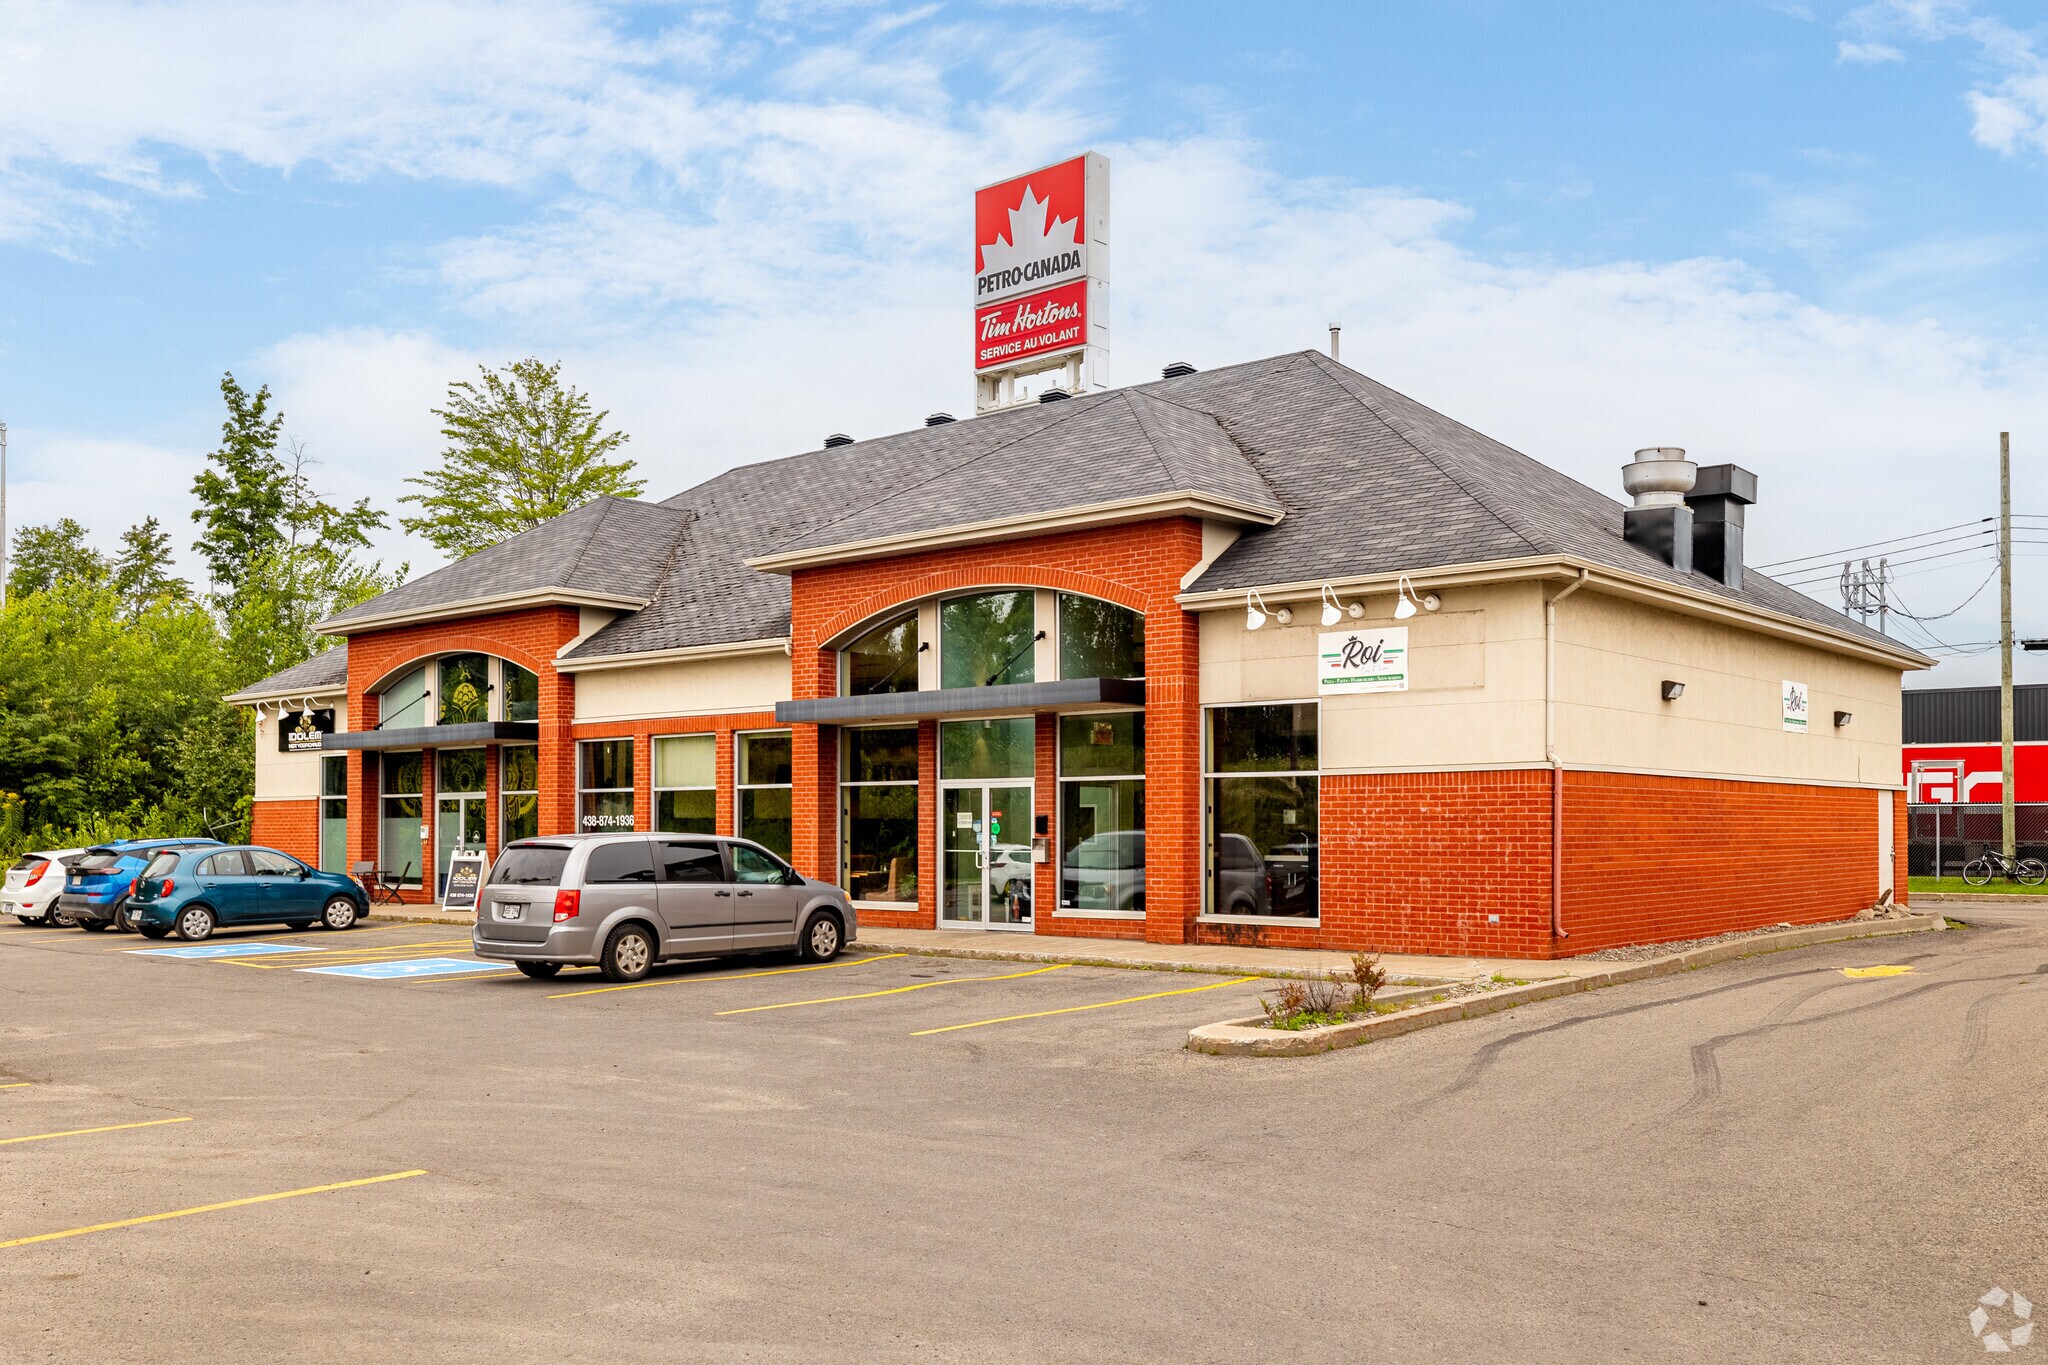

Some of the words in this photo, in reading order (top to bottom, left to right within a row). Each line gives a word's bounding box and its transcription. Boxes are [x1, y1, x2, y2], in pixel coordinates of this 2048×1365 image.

[978, 250, 1081, 295] PETRO-CANADA
[980, 310, 1011, 341] Tim
[980, 341, 1021, 361] SERVICE
[1023, 335, 1037, 350] AU
[1039, 326, 1080, 346] VOLANT
[1342, 638, 1384, 669] Roi
[288, 731, 322, 741] IDOLEM
[582, 815, 635, 827] 438-874-1936
